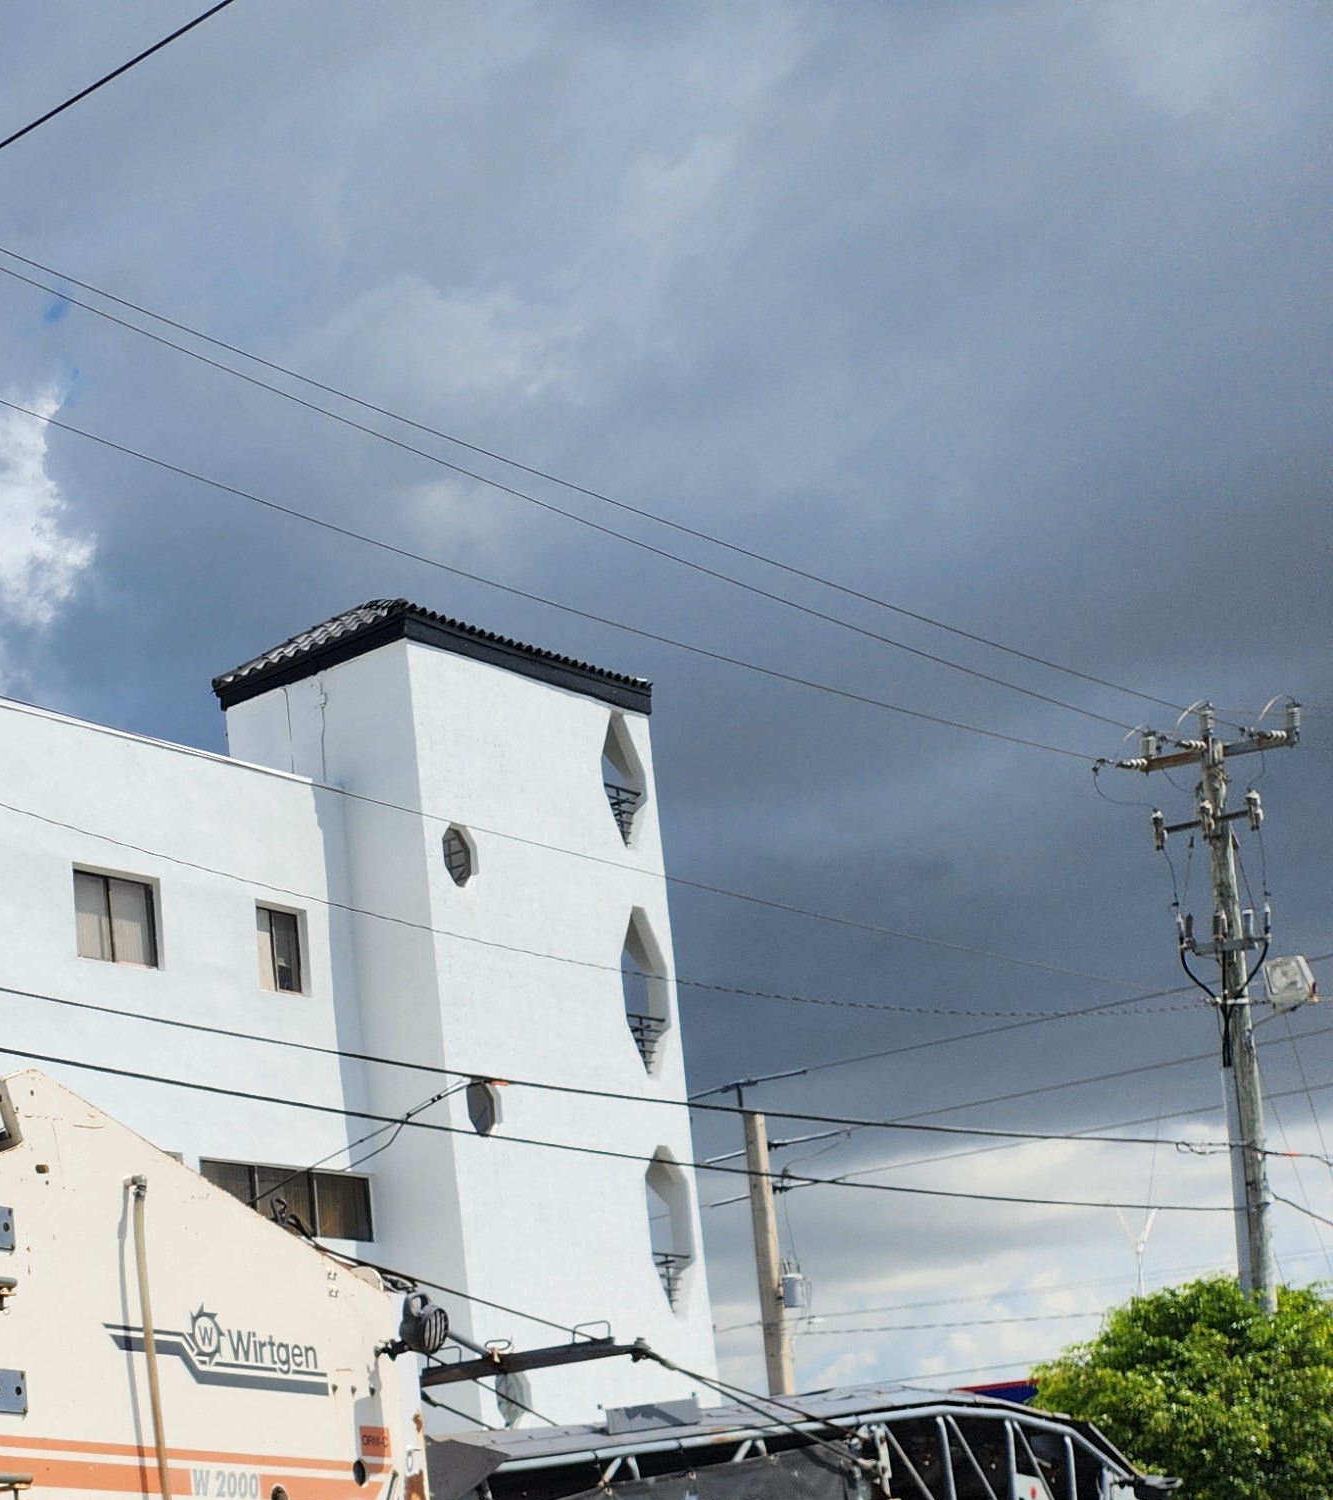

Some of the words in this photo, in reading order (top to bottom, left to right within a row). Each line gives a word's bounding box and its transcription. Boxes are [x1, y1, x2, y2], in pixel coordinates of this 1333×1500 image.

[226, 1328, 318, 1375] Wirtgen
[192, 1469, 211, 1497] W
[214, 1470, 259, 1500] 2000
